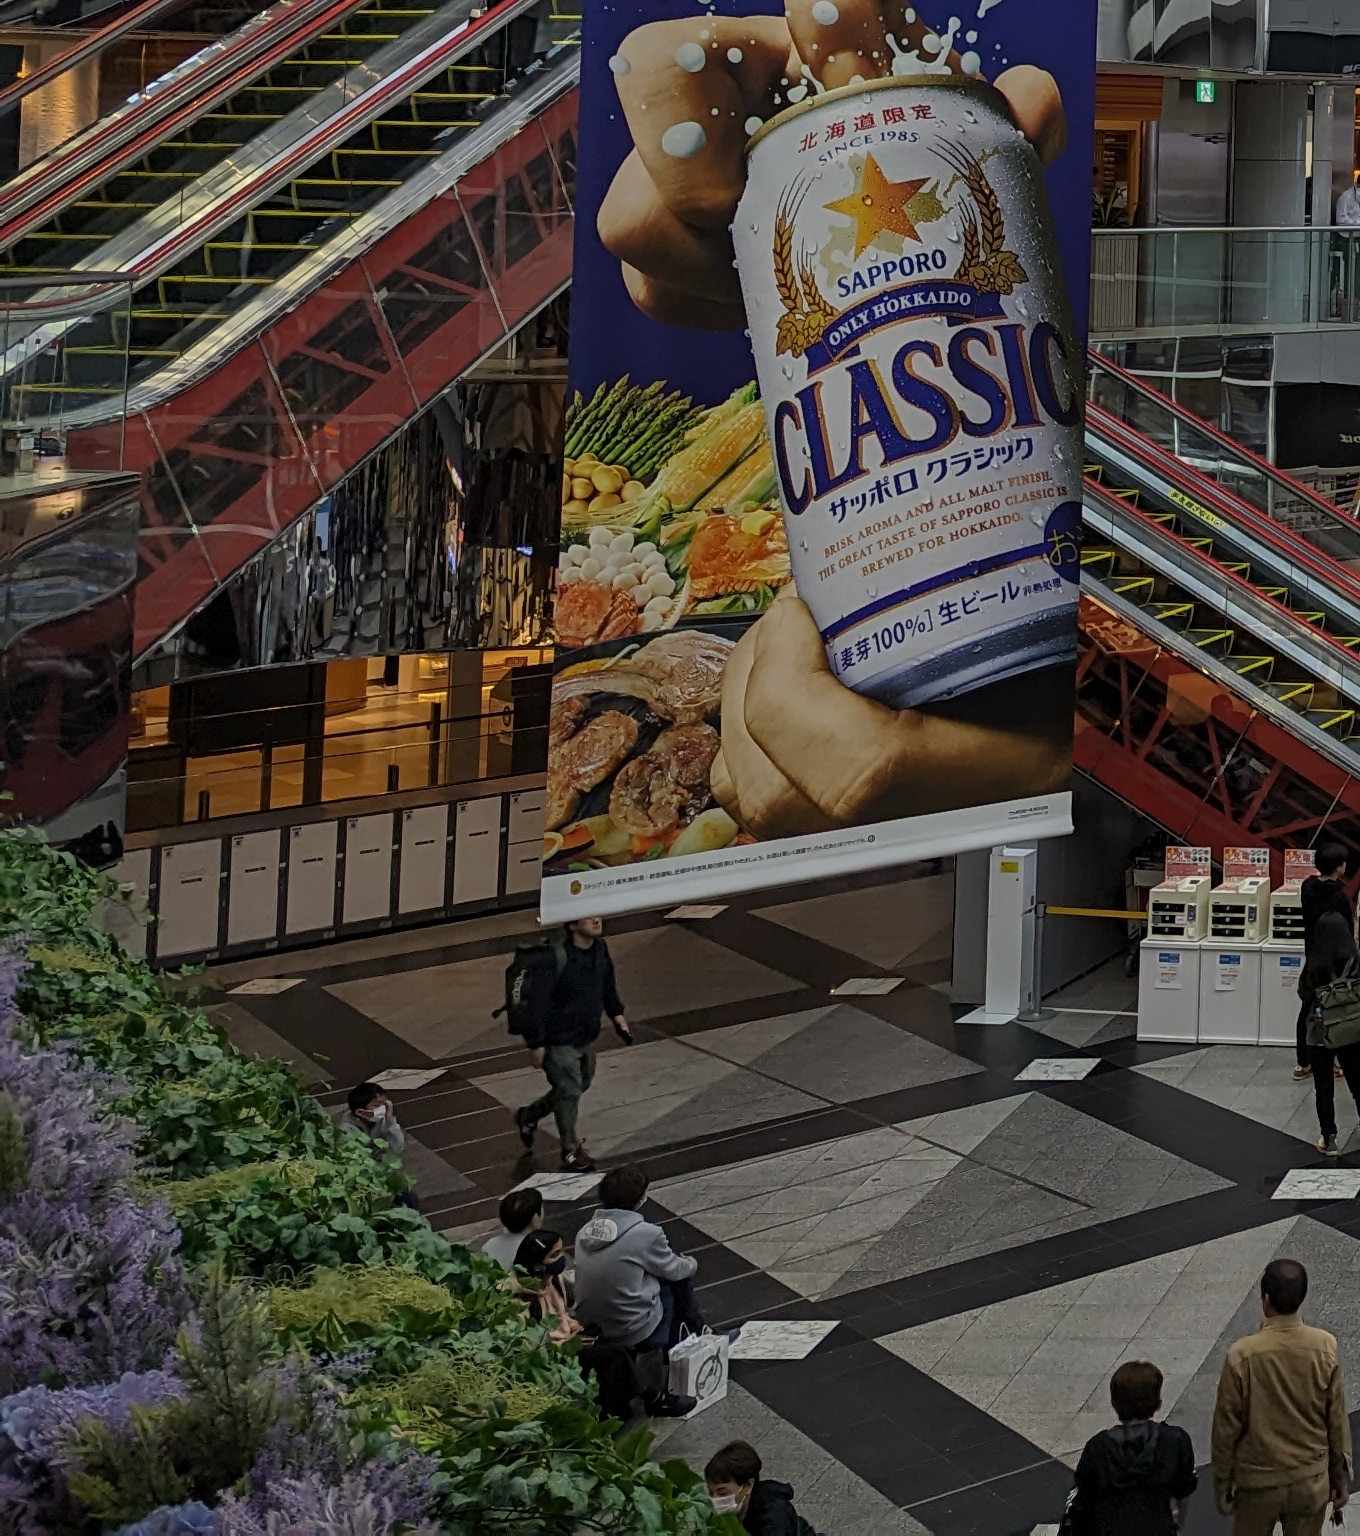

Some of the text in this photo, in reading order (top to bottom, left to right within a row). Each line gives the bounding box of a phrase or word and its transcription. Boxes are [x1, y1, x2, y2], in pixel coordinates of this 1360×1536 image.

[798, 104, 936, 154] 北海道限定
[818, 131, 920, 167] SINCE 1985
[837, 249, 947, 298] SAPPORO
[828, 290, 972, 347] ONLY HOKKAIDO
[775, 321, 1083, 516] CLASSIC
[829, 437, 1034, 524] サッポロ クラシック
[817, 486, 1069, 582] THE GREAT TASTE OF SAPPORO CLASSIC IS
[824, 532, 855, 559] BRISK
[858, 515, 901, 541] AROMA
[906, 502, 935, 521] AND
[939, 492, 965, 509] ALL
[969, 480, 1005, 499] MALT
[861, 512, 1024, 578] BREWED FOR HOKKAIDO.
[833, 608, 933, 677] [麦芽100%]
[937, 581, 1020, 627] 生ビール
